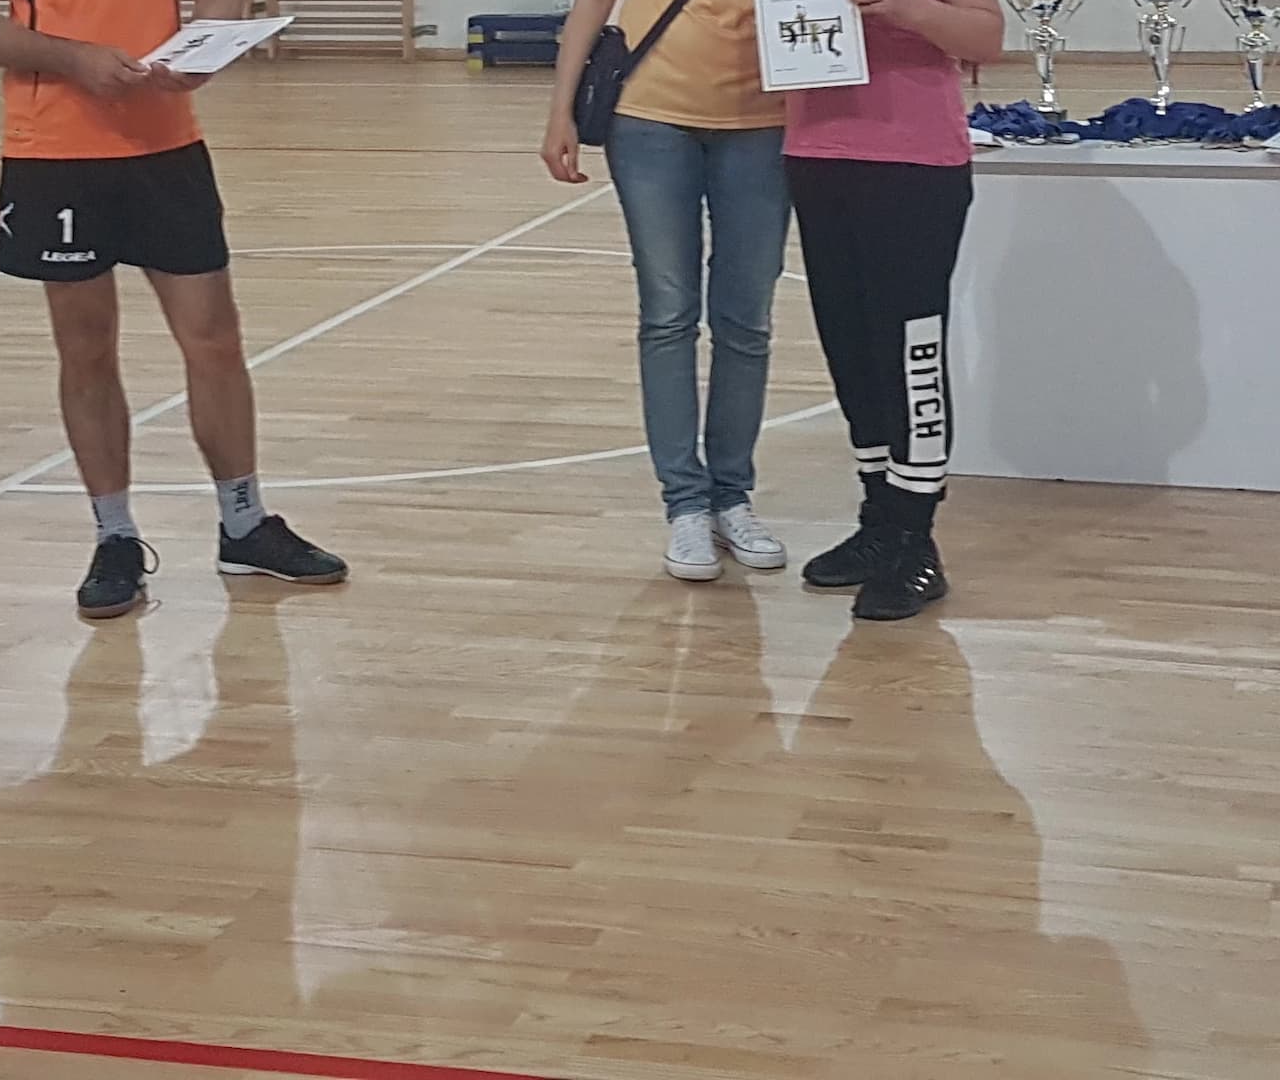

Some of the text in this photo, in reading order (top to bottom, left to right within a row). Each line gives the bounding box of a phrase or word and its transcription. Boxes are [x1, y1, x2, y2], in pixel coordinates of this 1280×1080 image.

[57, 208, 73, 243] 1
[41, 250, 97, 262] LEGEA
[910, 341, 944, 438] BITCH
